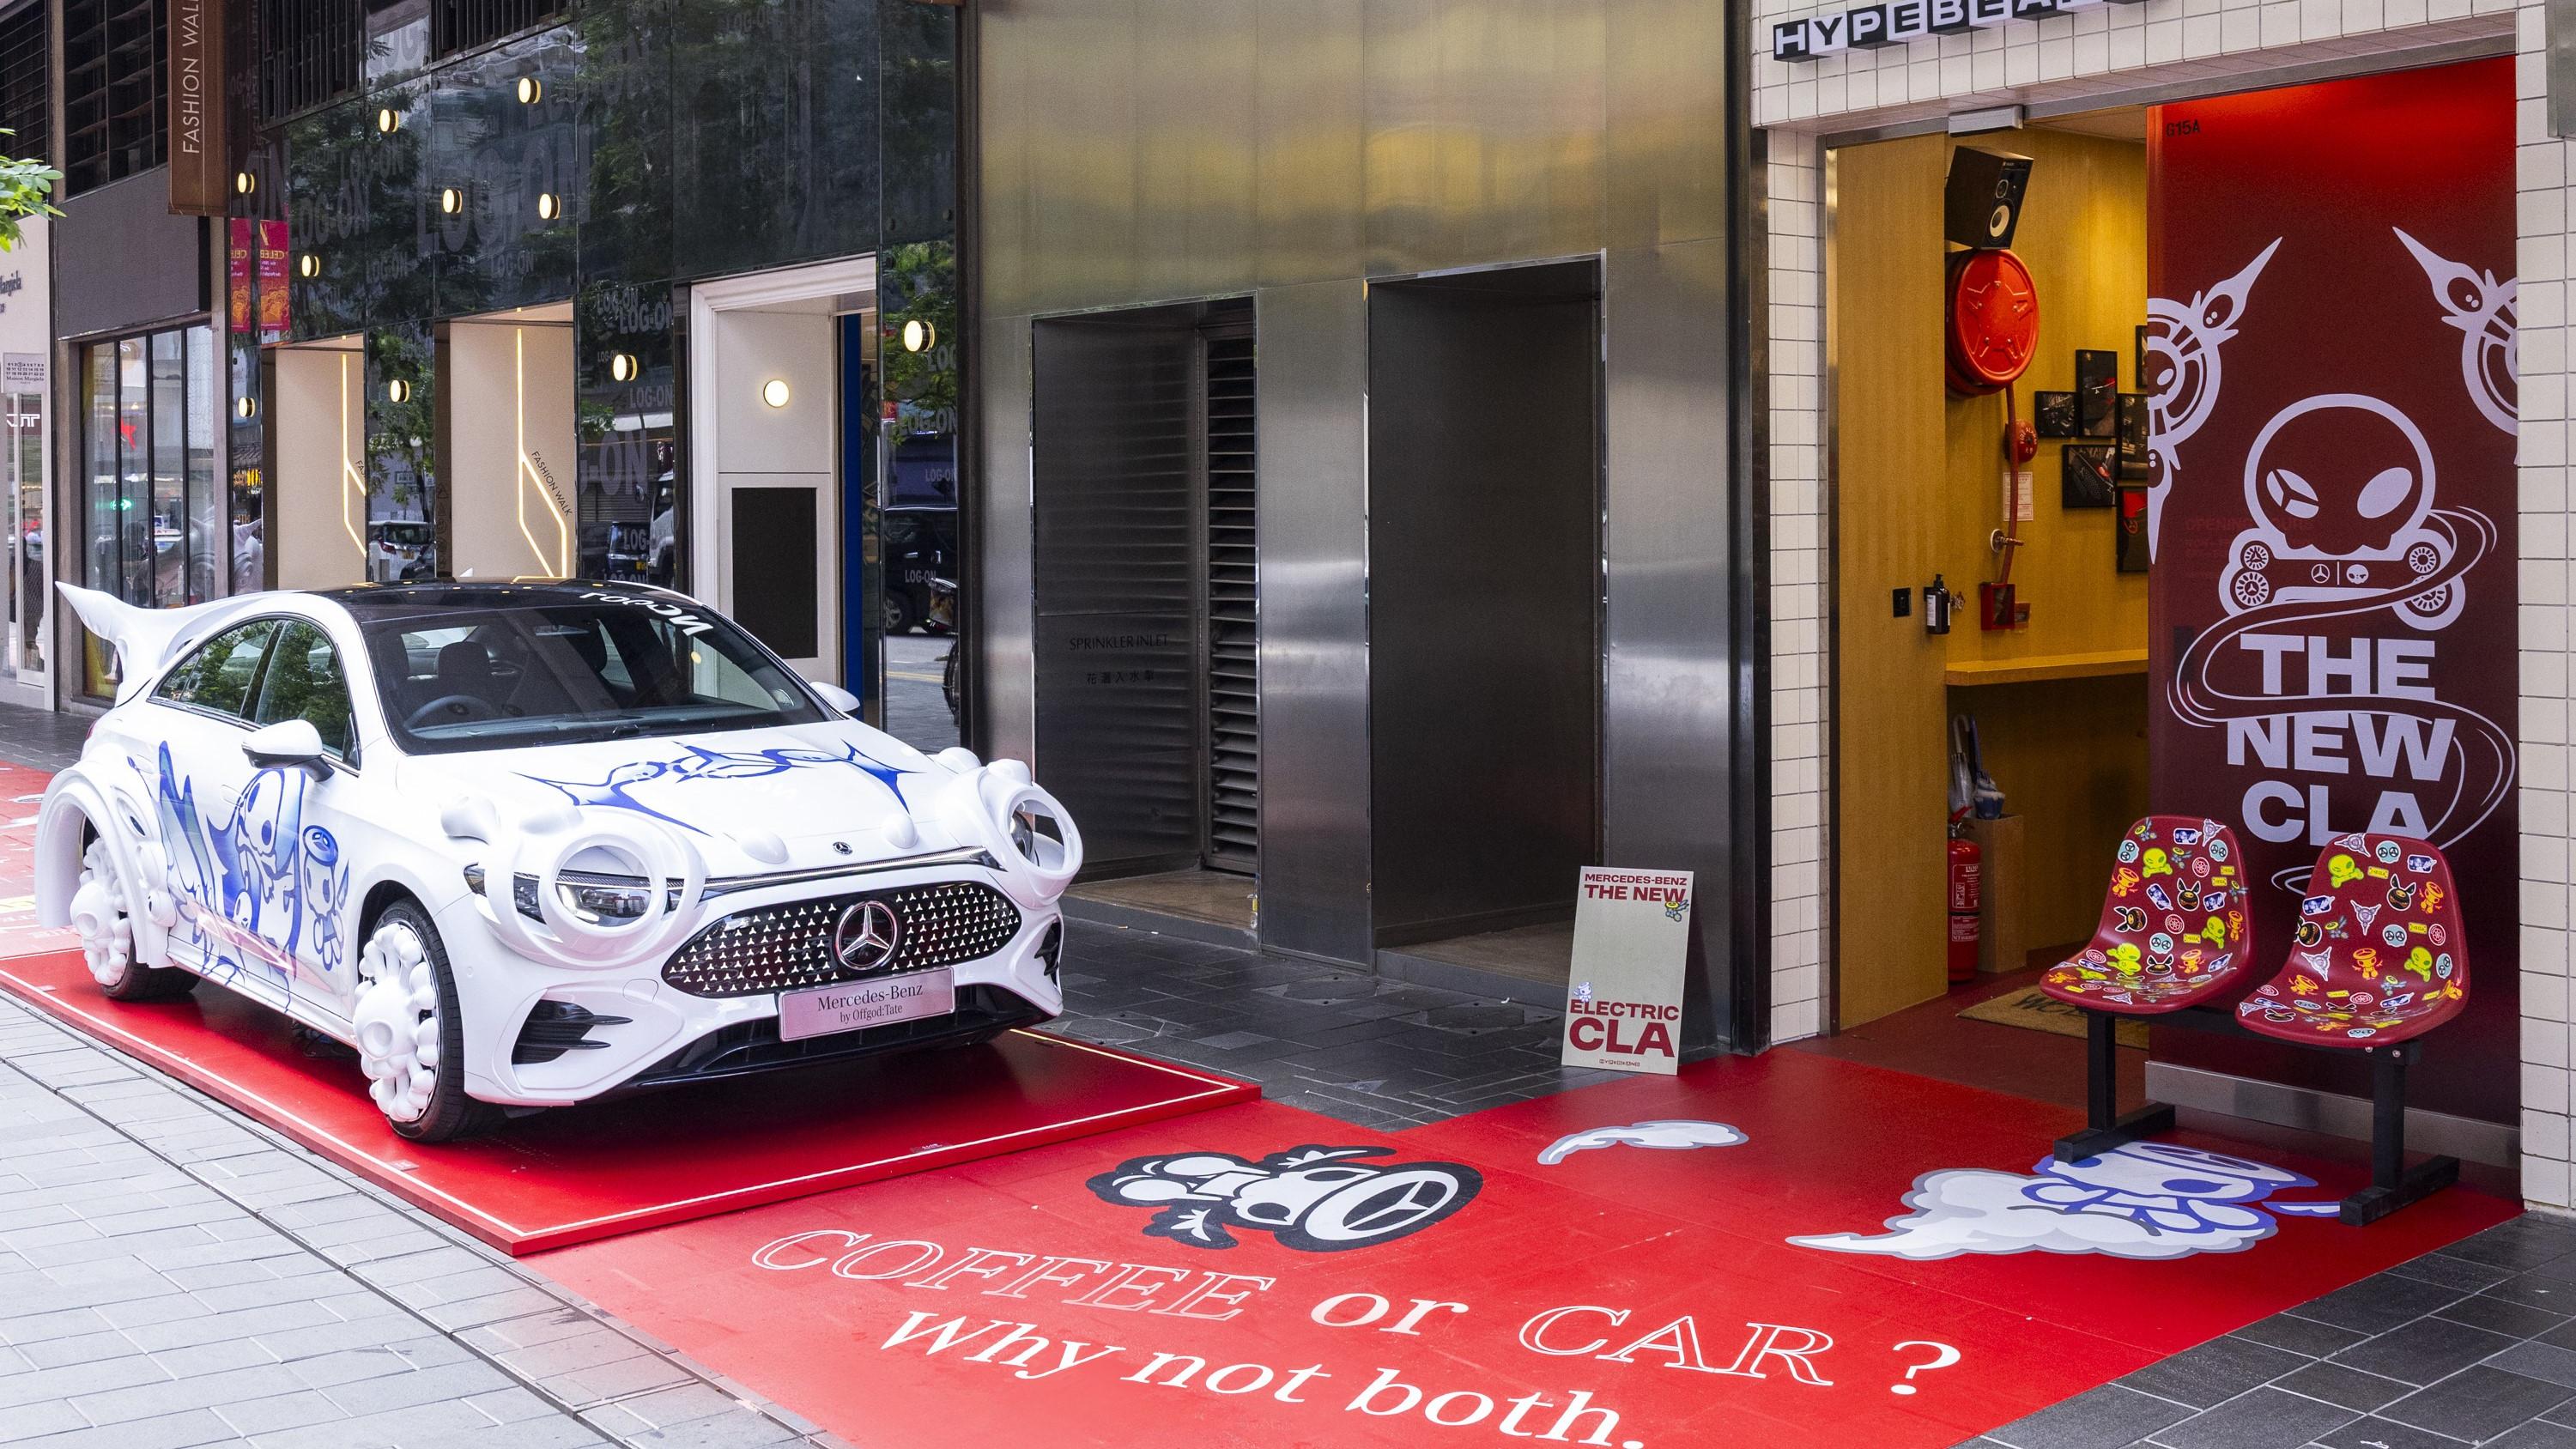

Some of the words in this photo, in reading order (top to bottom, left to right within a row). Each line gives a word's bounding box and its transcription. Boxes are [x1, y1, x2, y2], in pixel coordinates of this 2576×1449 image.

[183, 0, 200, 46] WAL
[183, 58, 200, 154] FASHION
[2166, 118, 2201, 137] G15A
[629, 385, 673, 409] LOG-ON
[531, 451, 559, 491] FASHION
[555, 490, 573, 517] WALK
[905, 569, 936, 584] LOG-ON
[1070, 635, 1134, 651] SPRINKLER
[1136, 634, 1168, 647] INLET
[2240, 634, 2435, 700] THE
[2227, 712, 2456, 782] NEW
[2242, 780, 2431, 846] CLA
[1584, 884, 1627, 900] THE
[1633, 886, 1686, 902] NEW
[1585, 873, 1688, 886] MERCEDES-BENZ
[817, 985, 924, 1011] Mercedes-Benz
[839, 1011, 851, 1024] by
[852, 1003, 903, 1021] Offgod:Tate
[1570, 998, 1679, 1021] ELECTRIC
[1569, 1016, 1675, 1058] CLA
[752, 1230, 1276, 1322] COFFEE
[1311, 1293, 1469, 1336] or
[1519, 1306, 1834, 1386] CAR
[1891, 1341, 1961, 1395] ?
[881, 1310, 1127, 1379] Why
[1120, 1352, 1332, 1404] not
[1345, 1367, 1644, 1449] both.
